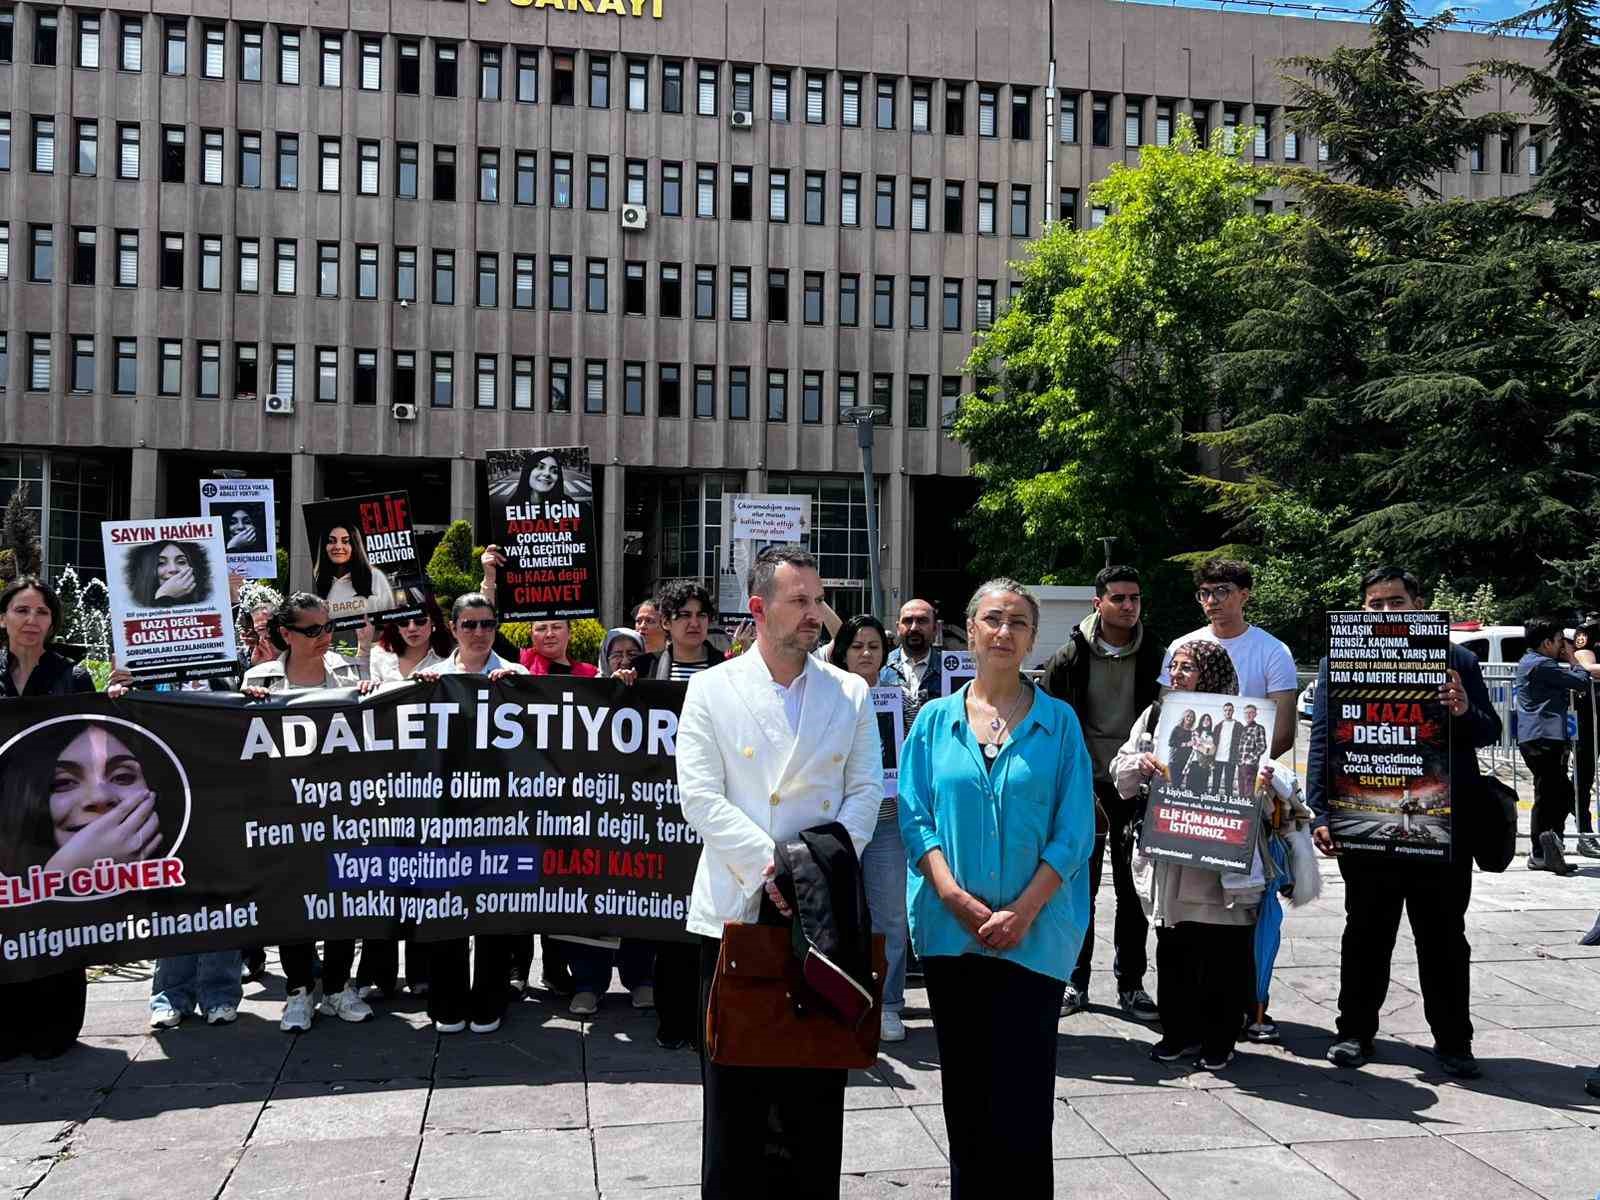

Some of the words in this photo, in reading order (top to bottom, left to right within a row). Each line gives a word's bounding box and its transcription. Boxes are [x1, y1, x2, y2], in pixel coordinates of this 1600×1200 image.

[359, 495, 406, 534] ELİF
[506, 501, 541, 520] ELİF
[544, 500, 580, 523] İÇİN
[111, 526, 156, 542] SAYIN
[508, 519, 582, 534] ADALET
[366, 530, 411, 552] ADALET
[516, 532, 572, 545] ÇOCUKLAR
[504, 546, 530, 556] YAYA
[532, 542, 586, 556] GEÇİTİNDE
[520, 555, 572, 568] ÖLMEMELİ
[506, 571, 519, 584] Bu
[525, 570, 555, 582] KAZA
[558, 568, 588, 584] değil
[514, 584, 582, 604] CİNAYET
[140, 620, 168, 630] KAZA
[1330, 614, 1338, 622] 19
[1340, 614, 1362, 624] ŞUBAT
[1363, 613, 1384, 624] GÜNÜ,
[1386, 614, 1402, 622] YAYA
[132, 630, 170, 644] OLASI
[172, 626, 215, 640] KAST!
[1330, 624, 1373, 637] YAKLAŞIK
[1409, 623, 1448, 636] SÜRATLE
[1330, 636, 1367, 648] FRENSİZ,
[1368, 637, 1409, 649] KAÇINMA
[126, 646, 173, 656] SORUMLULARI
[1330, 648, 1379, 659] MANEVRASI
[1381, 648, 1400, 660] YOK,
[1402, 649, 1427, 661] YARIŞ
[1428, 649, 1446, 659] VAR
[1330, 661, 1354, 670] SADECE
[1354, 662, 1368, 670] SON
[1374, 662, 1398, 670] ADIMLA
[1330, 672, 1350, 682] TAM
[1352, 672, 1364, 683] 40
[1366, 672, 1397, 683] METRE
[1398, 672, 1446, 684] FIRLATILDI
[1342, 704, 1361, 719] BU
[1366, 703, 1424, 722] KAZA
[240, 702, 460, 760] ADALET
[1345, 752, 1369, 764] Yaya
[1371, 753, 1424, 766] geçidinde
[1344, 764, 1372, 774] çocuk
[1375, 764, 1424, 776] öldürmek
[291, 778, 342, 808] Yaya
[350, 772, 443, 806] geçidinde
[450, 771, 500, 799] ölüm
[508, 771, 566, 798] kader
[572, 772, 625, 804] değil,
[1360, 776, 1406, 788] suçtur!
[1158, 786, 1165, 794] 4
[1222, 794, 1228, 803] 3
[1160, 808, 1181, 822] ELİF
[1182, 810, 1203, 824] İÇİN
[1203, 815, 1243, 830] ADALET
[246, 821, 294, 848] Fren
[300, 820, 325, 842] ve
[333, 814, 415, 846] kaçınma
[420, 810, 529, 845] yapmamak
[536, 810, 590, 836] ihmal
[598, 812, 650, 845] değil,
[1169, 820, 1227, 840] İSTİYORUZ.
[333, 852, 382, 883] Yaya
[388, 851, 472, 884] geçitinde
[480, 850, 509, 875] hız
[518, 856, 533, 870] =
[543, 848, 600, 876] OLASI
[608, 850, 664, 880] KAST!
[71, 860, 184, 893] GÜNER
[304, 892, 334, 920] Yol
[342, 890, 394, 918] hakkı
[400, 891, 468, 925] yayada,
[476, 887, 588, 914] sorumluluk
[594, 889, 691, 920] sürücüde!
[0, 902, 258, 960] elifgunericinadalet
